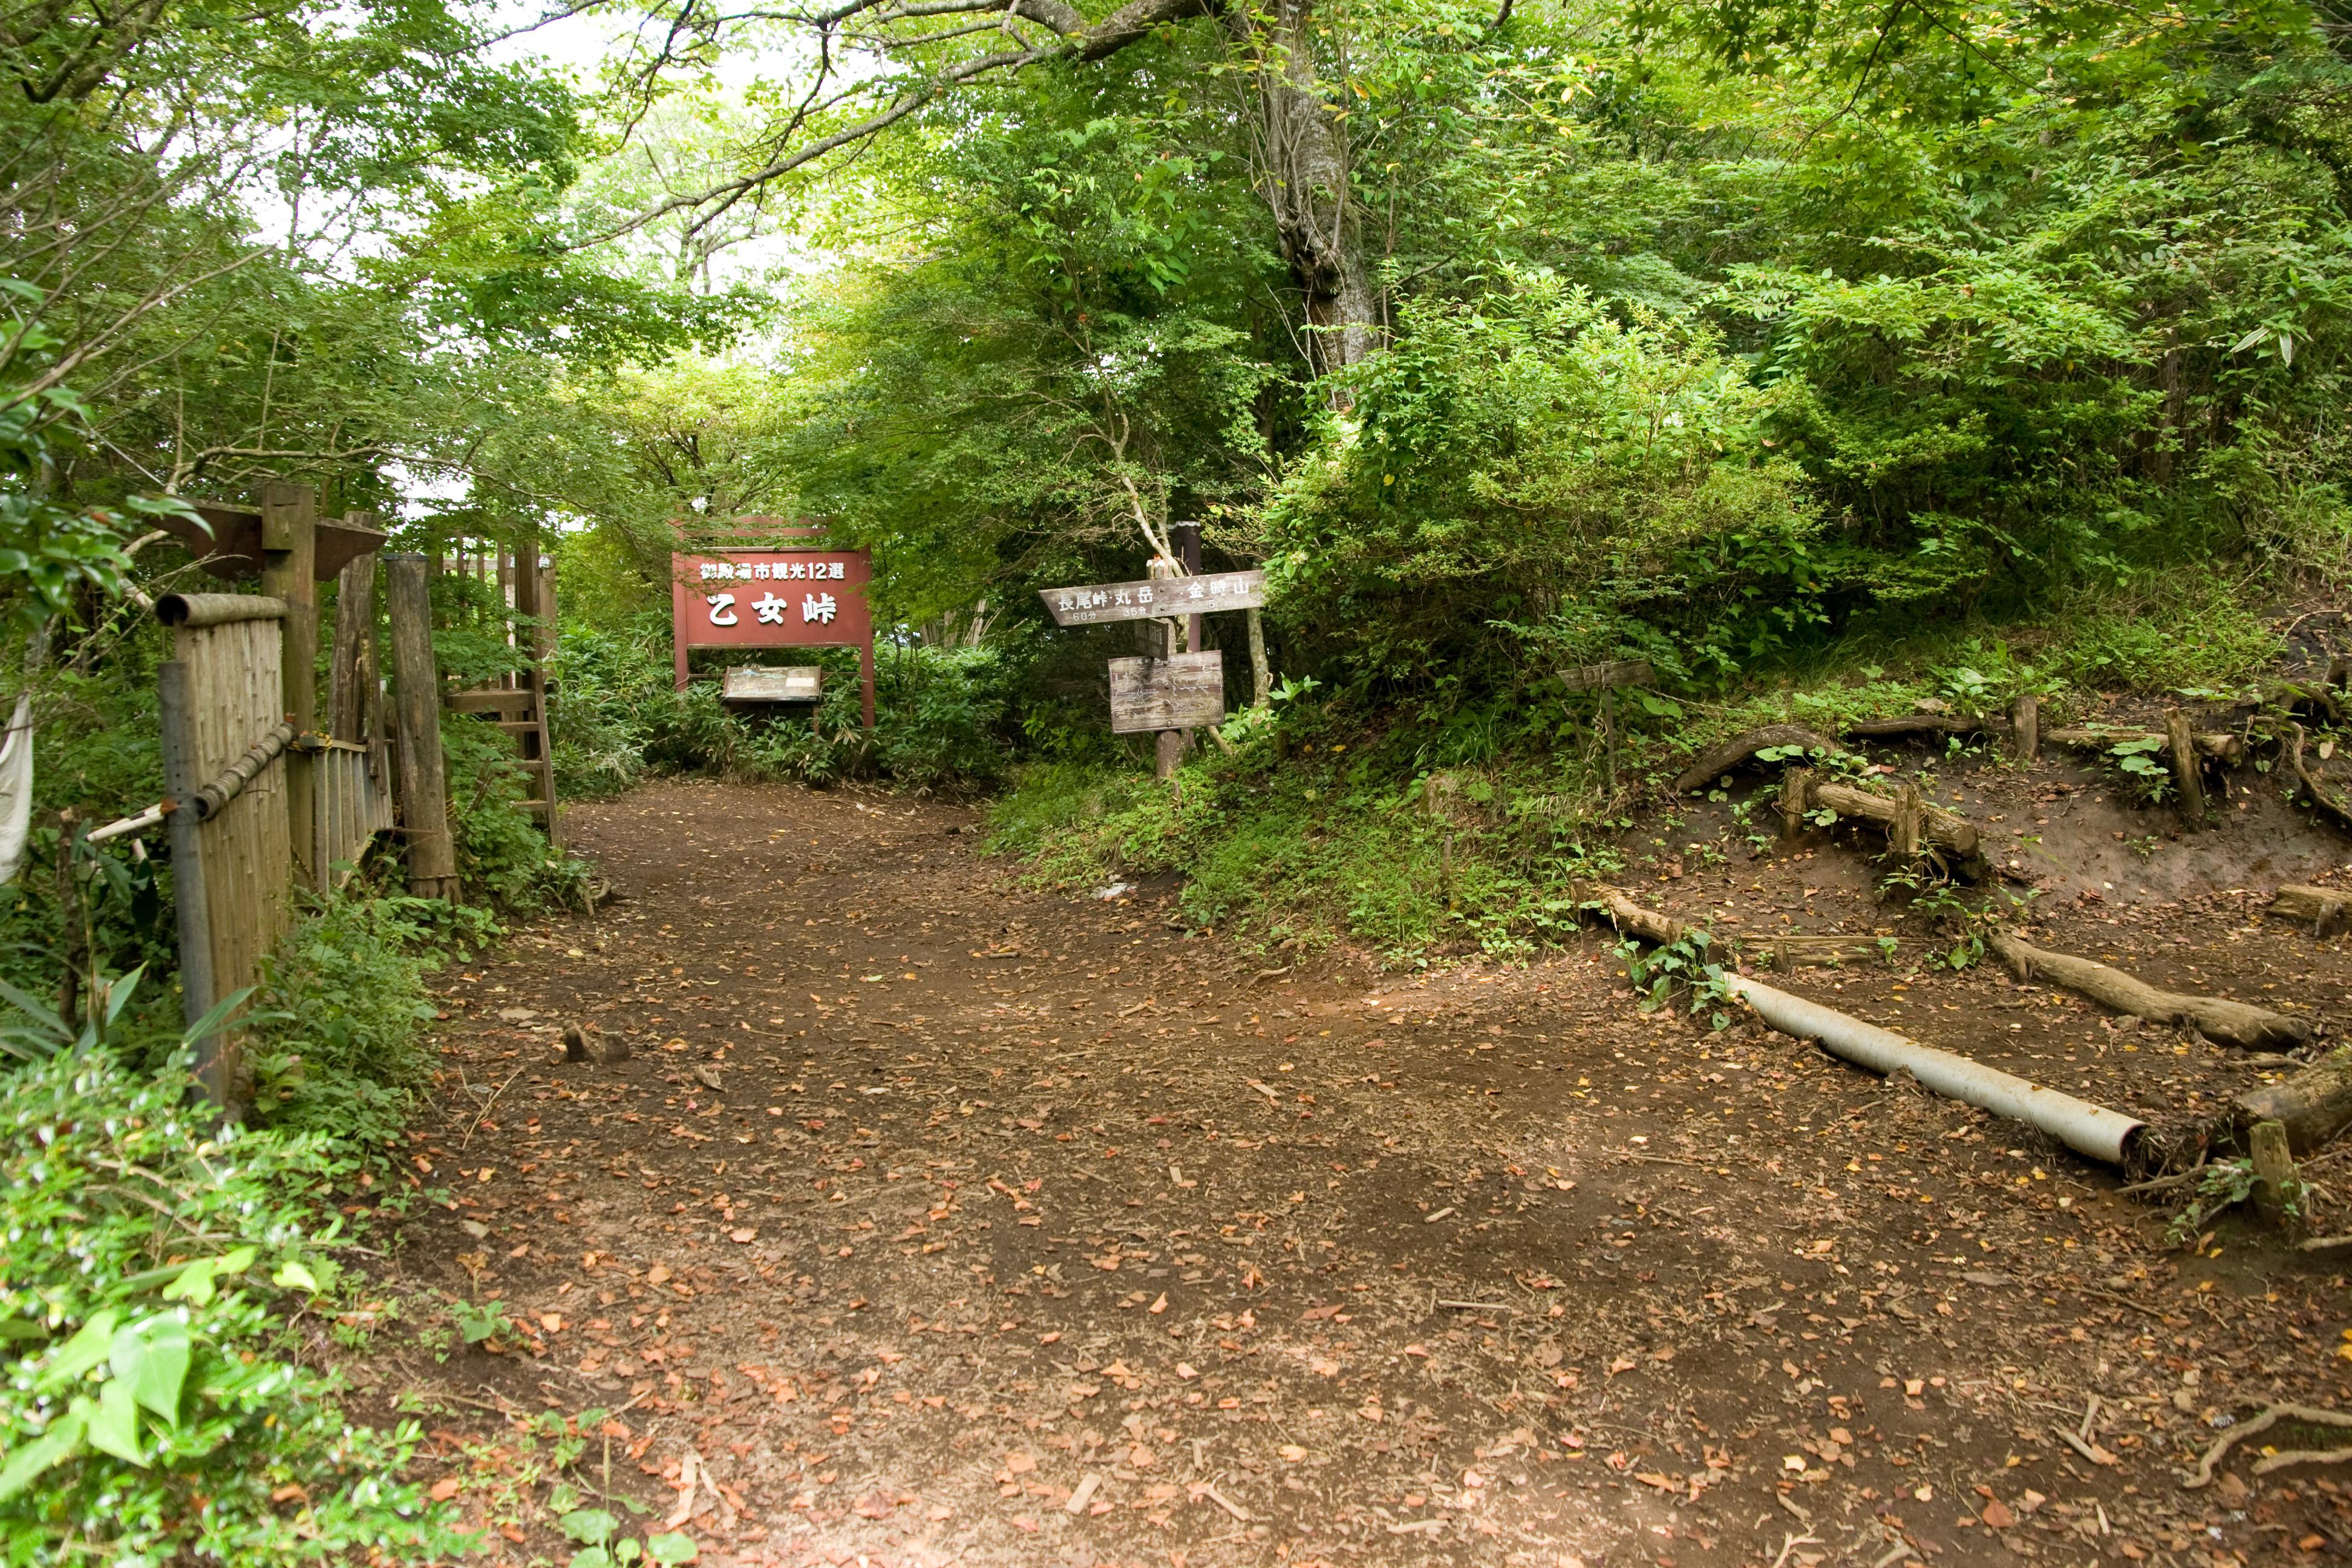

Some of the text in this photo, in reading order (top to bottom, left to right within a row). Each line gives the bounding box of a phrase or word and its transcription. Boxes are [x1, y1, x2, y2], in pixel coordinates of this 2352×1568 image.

[1187, 577, 1249, 599] 金時山
[707, 592, 837, 626] 乙女峠
[1073, 612, 1097, 621] 60分
